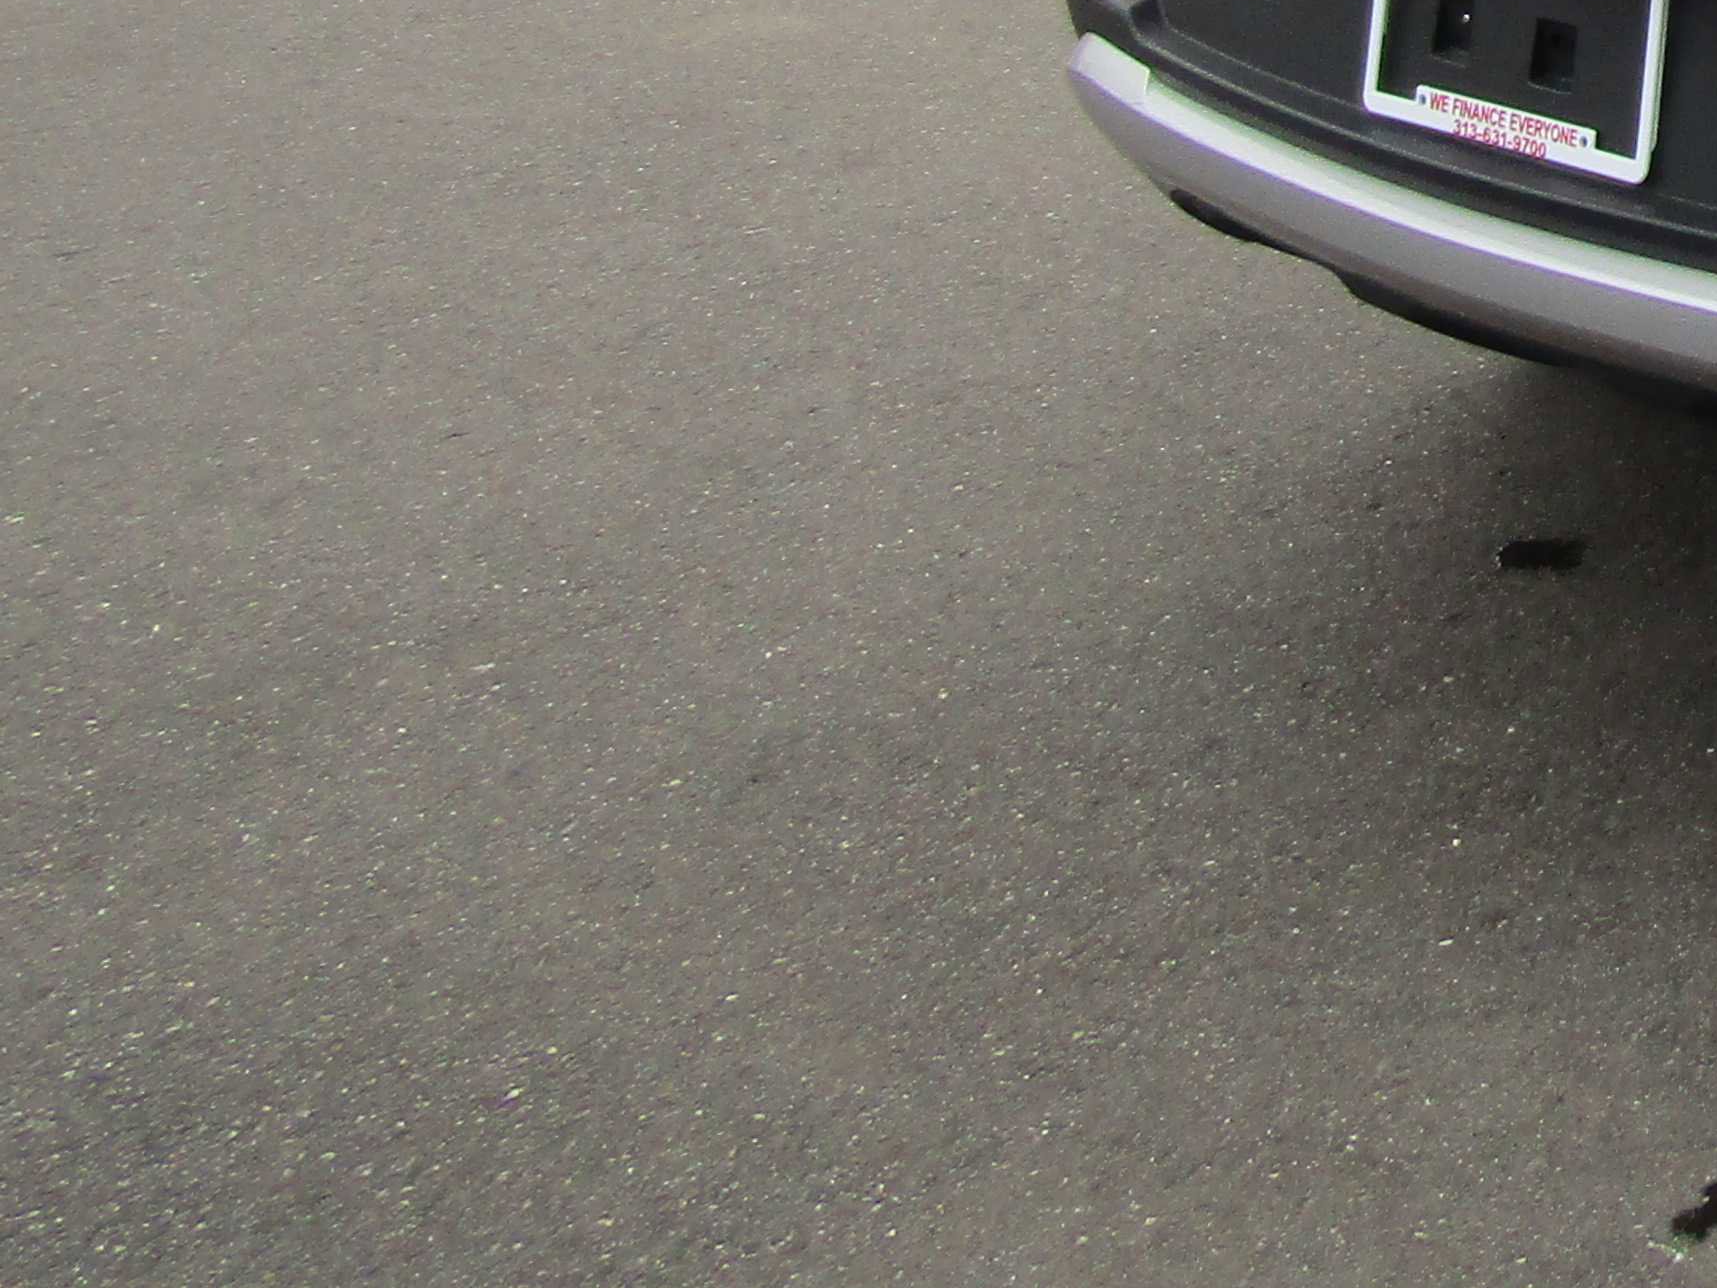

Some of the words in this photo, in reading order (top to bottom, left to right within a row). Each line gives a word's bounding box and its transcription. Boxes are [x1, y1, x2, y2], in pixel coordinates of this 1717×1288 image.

[1429, 92, 1449, 113] WE
[1452, 98, 1507, 128] FINANCE
[1509, 113, 1579, 148] EVERYONE
[1452, 119, 1547, 160] 313-631-9700
